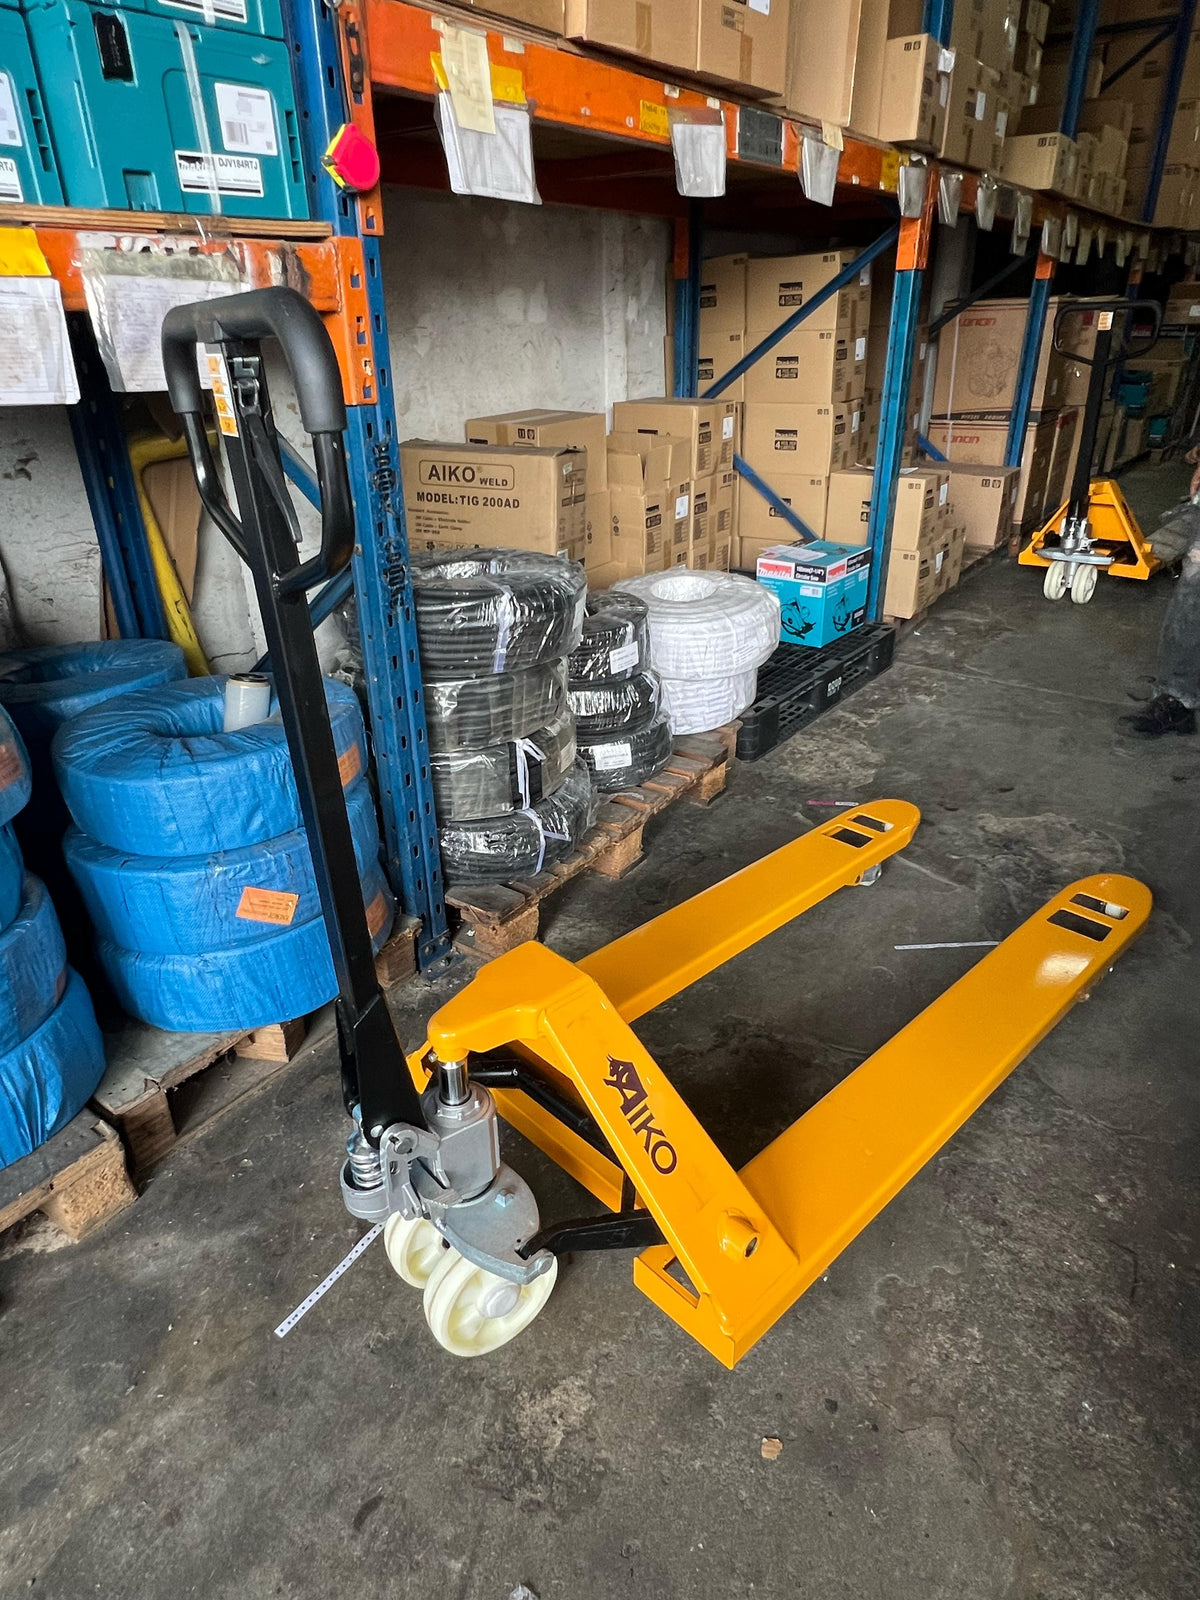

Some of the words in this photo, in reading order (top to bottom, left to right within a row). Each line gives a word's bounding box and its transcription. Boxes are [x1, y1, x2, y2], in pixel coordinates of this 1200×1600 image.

[428, 464, 476, 483] AIKO
[479, 477, 508, 487] WELD
[482, 497, 520, 509] 200AD
[602, 1054, 678, 1175] AIKO
